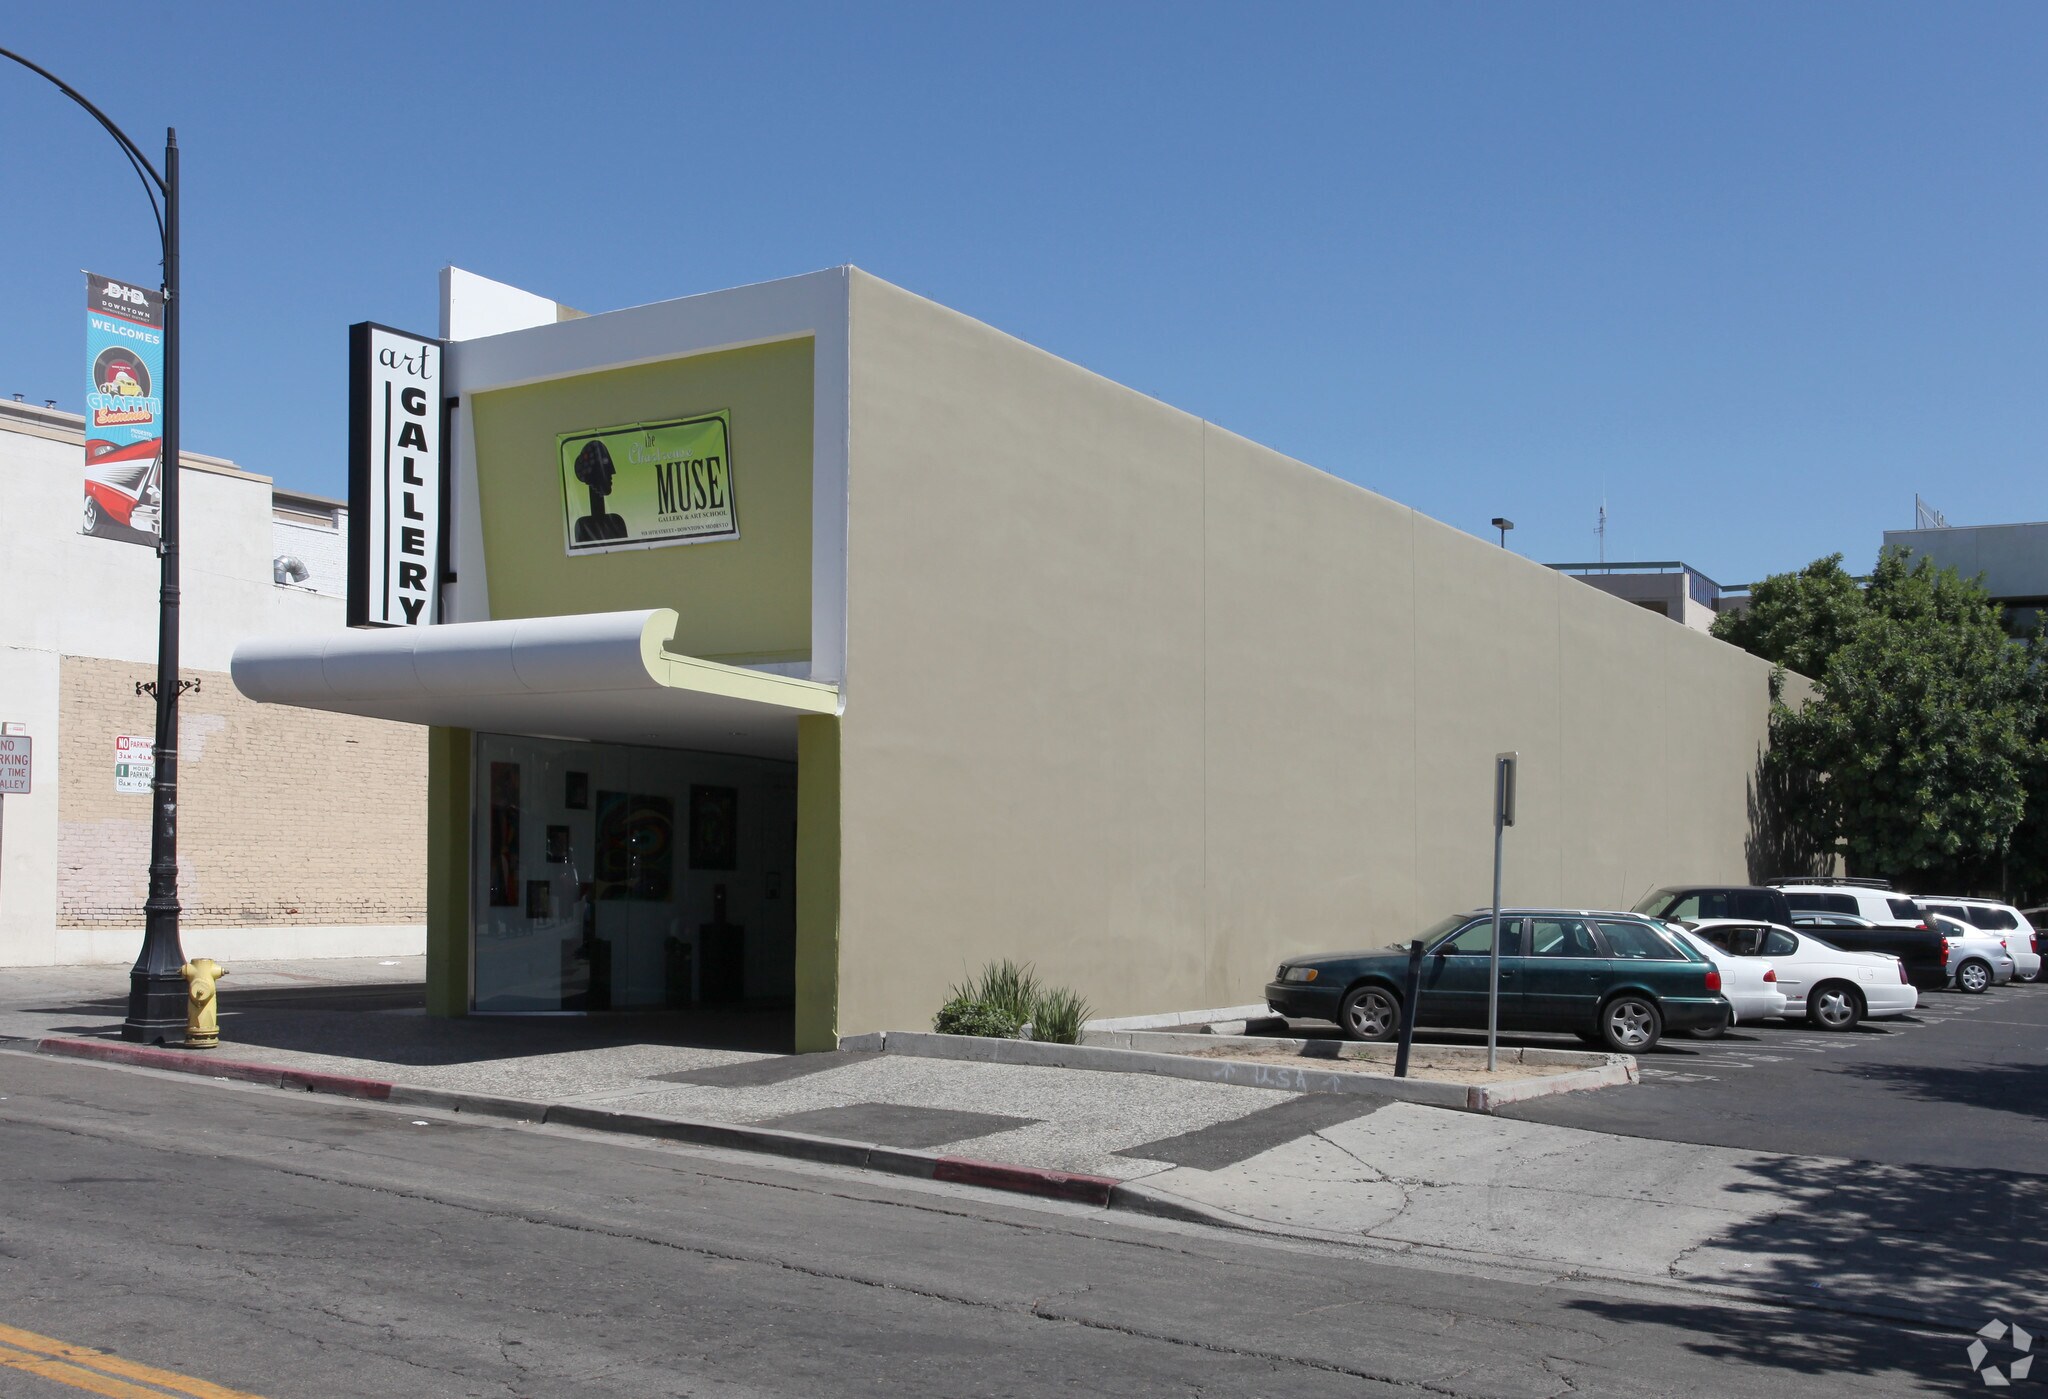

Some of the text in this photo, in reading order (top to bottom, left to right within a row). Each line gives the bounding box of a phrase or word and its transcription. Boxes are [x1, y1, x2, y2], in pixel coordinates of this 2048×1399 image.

[101, 300, 151, 318] DOWNTOWN
[91, 318, 160, 345] WELCOMES
[379, 345, 433, 380] art
[87, 392, 160, 414] GRAFFITI
[97, 407, 150, 423] Summer
[130, 428, 153, 437] MODESTO
[644, 432, 656, 448] the
[655, 456, 724, 515] MUSE
[397, 386, 429, 625] GALLERY
[658, 515, 684, 523] GALLERY
[691, 512, 702, 520] ART
[702, 510, 728, 518] SCHOOL
[676, 525, 704, 533] DOWNTOWN
[705, 522, 729, 530] MODESTO
[0, 740, 15, 752] NO
[118, 738, 128, 749] NO
[8, 767, 26, 777] TIME
[120, 765, 124, 776] 1
[130, 770, 152, 779] PARKING
[1254, 1066, 1307, 1096] USA
